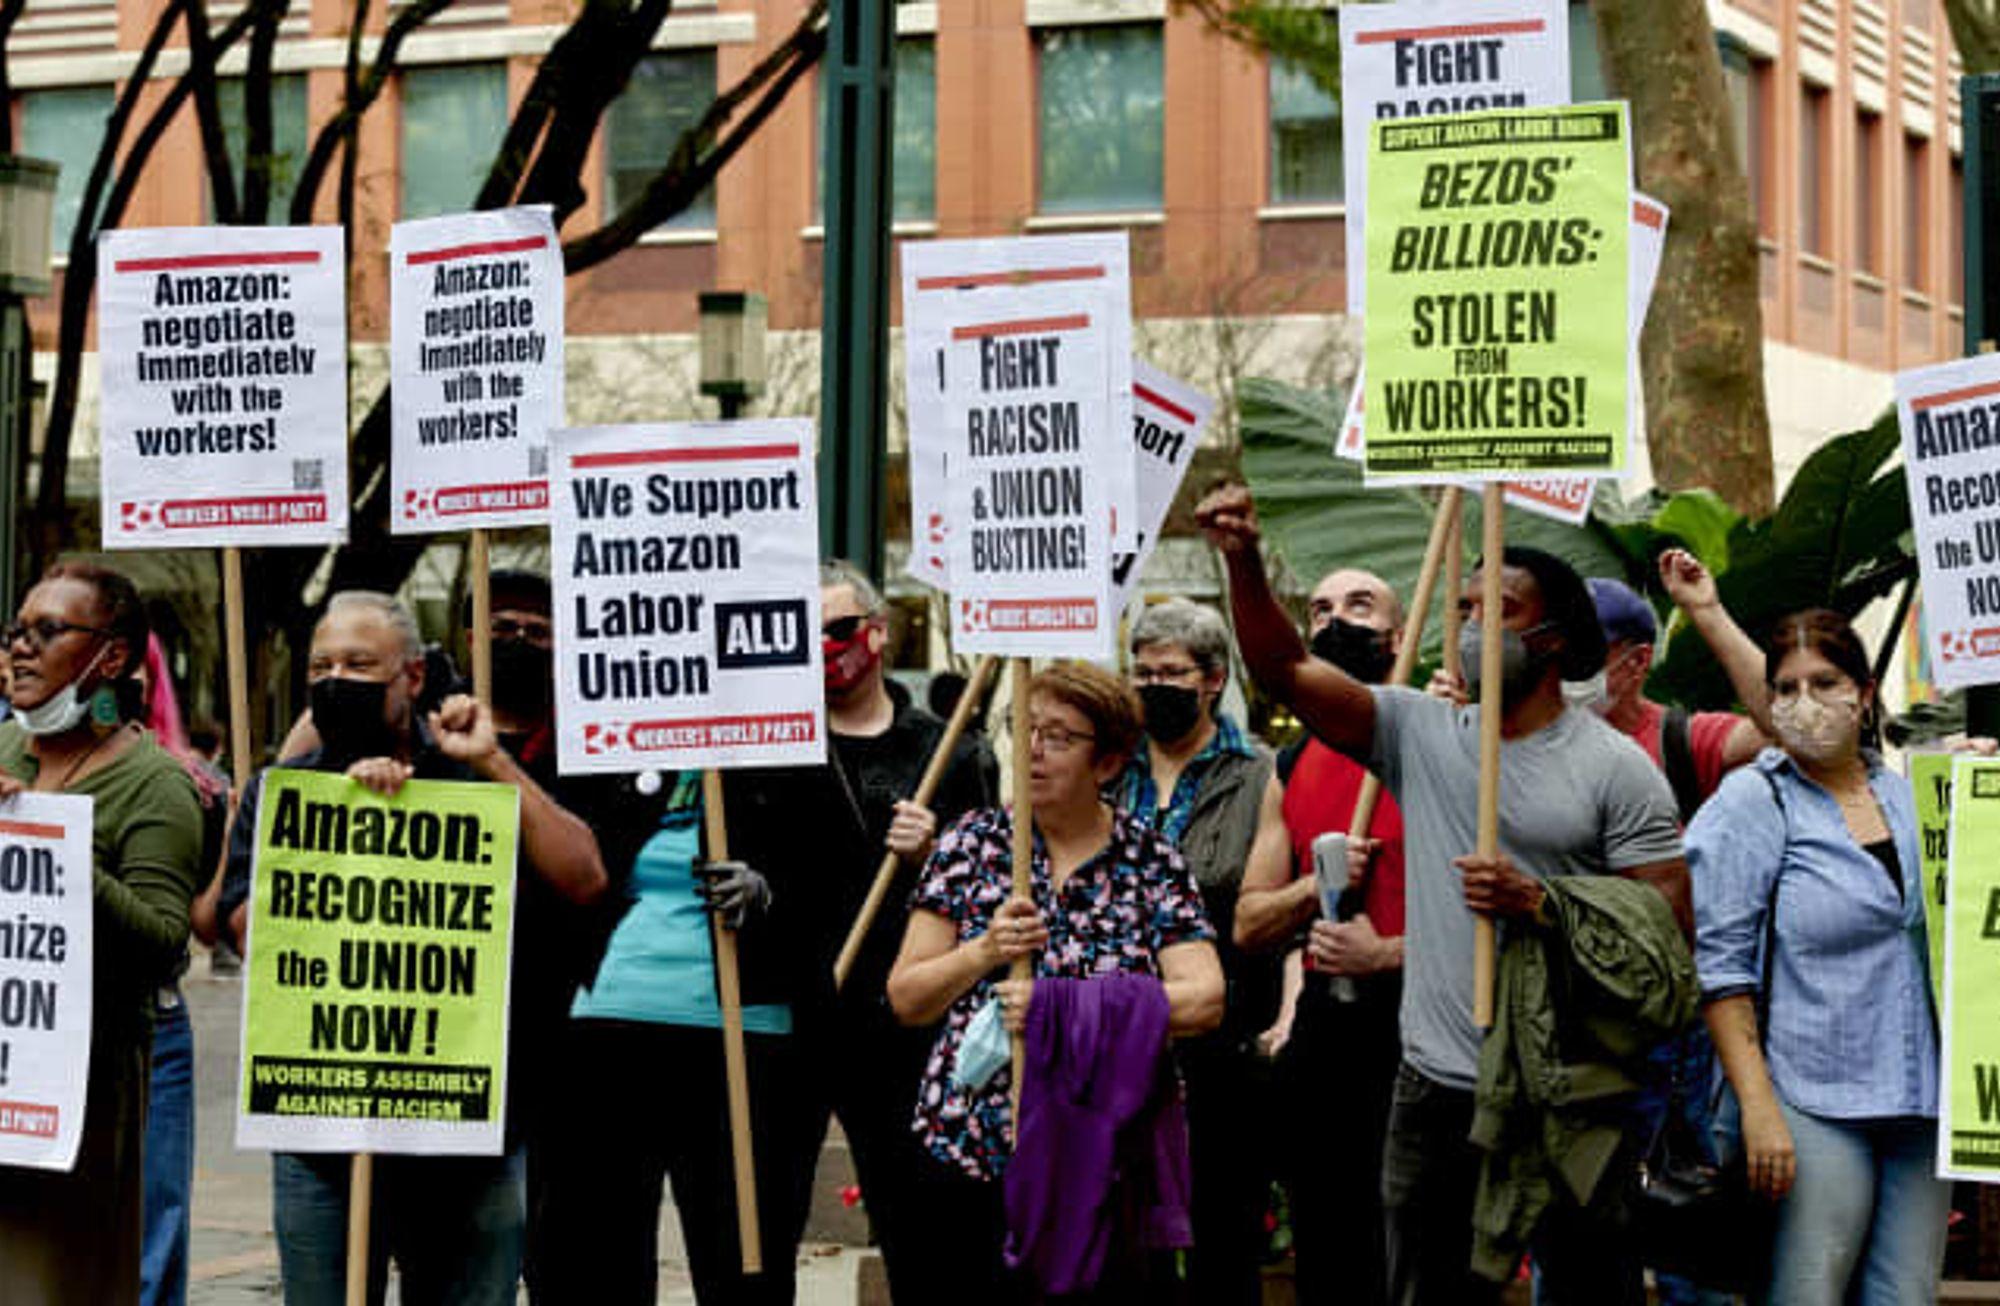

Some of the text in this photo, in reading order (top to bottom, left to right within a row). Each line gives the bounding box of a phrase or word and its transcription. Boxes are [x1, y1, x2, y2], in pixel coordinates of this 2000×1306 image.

[1395, 38, 1502, 87] FIGHT
[1420, 157, 1573, 209] BEZOS'
[1391, 219, 1601, 273] BILLIONS:
[155, 273, 290, 306] Amazon:
[434, 261, 530, 297] Amazon:
[143, 308, 297, 348] negotiate
[425, 294, 534, 338] negotiate
[1412, 291, 1556, 349] STOLEN
[979, 337, 1061, 391] FIGHT
[1455, 349, 1508, 376] FROM
[171, 384, 282, 415] with the
[443, 371, 523, 402] with the
[1384, 377, 1586, 432] WORKERS!
[135, 417, 276, 456] workers!
[418, 404, 518, 445] workers!
[968, 402, 1080, 457] RACISM
[572, 471, 800, 519] We Support
[991, 467, 1083, 519] UNION
[1925, 470, 2000, 516] Reco
[572, 533, 740, 578] Amazon
[972, 525, 1086, 573] BUSTING!
[1935, 537, 1973, 570] the
[575, 592, 704, 639] Labor
[727, 612, 797, 654] ALU
[578, 650, 709, 700] Union
[269, 787, 493, 864] Amazon:
[269, 869, 495, 932] RECOGNIZE
[277, 939, 477, 996] the UNION
[254, 1063, 488, 1095] WORKERS ASSEMBLY
[275, 1094, 462, 1121] AGAINST RACISM
